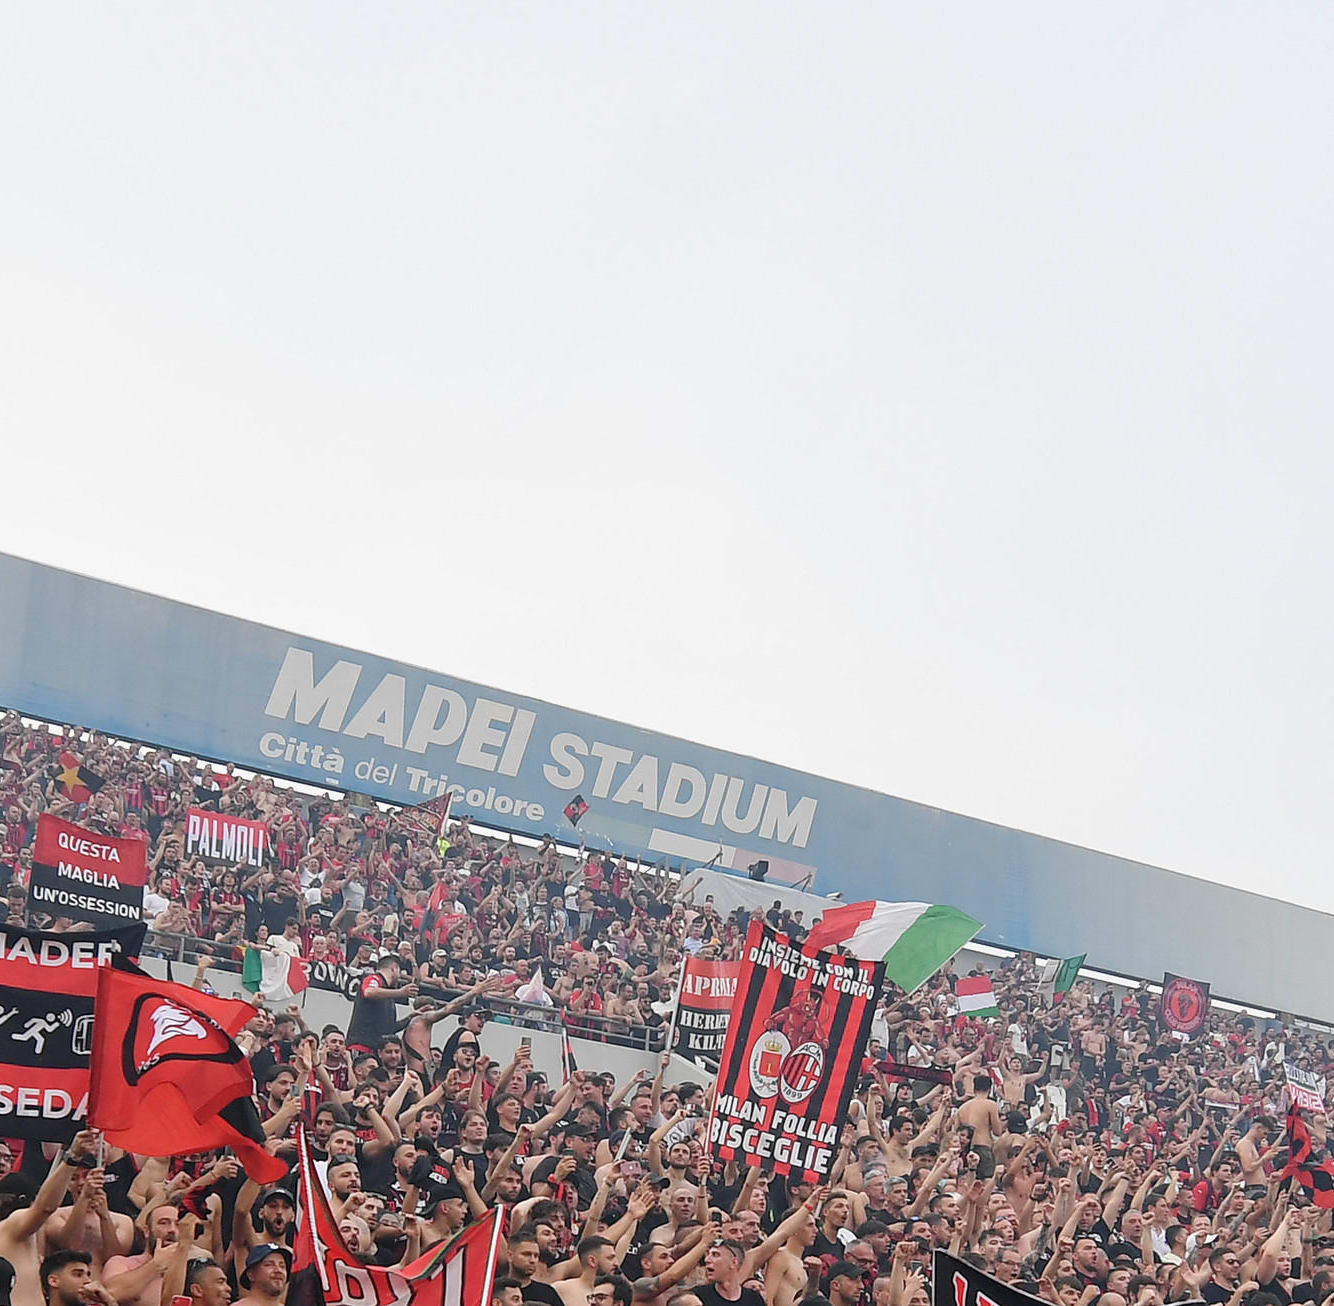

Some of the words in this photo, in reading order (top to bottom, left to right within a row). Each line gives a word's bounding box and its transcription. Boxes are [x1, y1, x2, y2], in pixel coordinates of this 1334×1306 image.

[265, 647, 537, 777] MAPEI
[543, 732, 818, 849] STADIUM
[259, 732, 345, 774] Città
[354, 757, 398, 786] del
[405, 766, 545, 822] Tricolore
[58, 832, 121, 862] QUESTA
[187, 815, 264, 867] PALMOLI
[58, 861, 120, 890] MAGLIA
[33, 885, 140, 920] UN'OSSESSION
[748, 948, 808, 981] DIAVOLO
[812, 968, 830, 989] IN
[833, 974, 875, 1000] CORPO
[761, 937, 822, 970] INSIEME
[825, 962, 855, 978] CON
[857, 968, 870, 984] IL
[715, 1092, 767, 1125] MILAN
[771, 1110, 838, 1146] FOLLIA
[709, 1118, 833, 1174] BISCEGLIE
